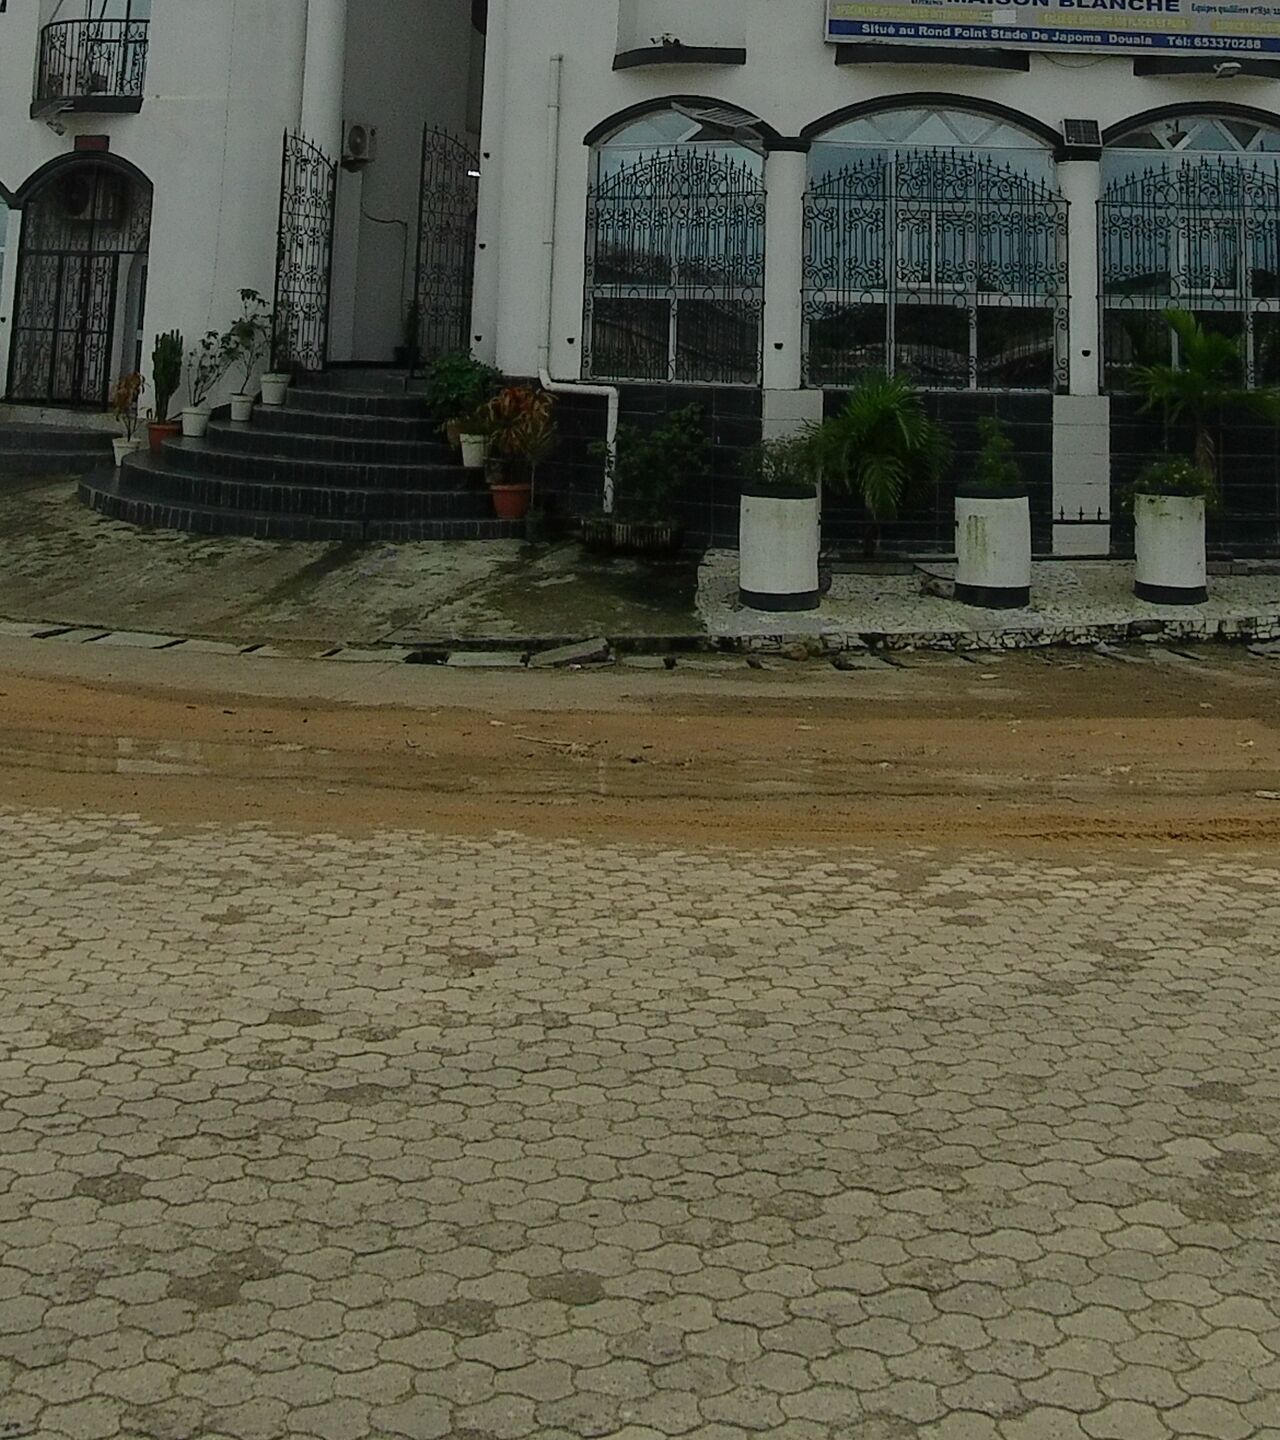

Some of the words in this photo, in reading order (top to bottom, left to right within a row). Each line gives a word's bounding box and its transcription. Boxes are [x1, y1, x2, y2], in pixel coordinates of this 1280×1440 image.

[862, 23, 895, 34] Situé
[899, 26, 915, 35] au
[919, 27, 951, 37] Rond
[954, 28, 987, 38] Point
[991, 29, 1027, 39] Stade
[1032, 30, 1048, 40] De
[1052, 32, 1101, 44] Japoma
[1109, 34, 1152, 45] Douala
